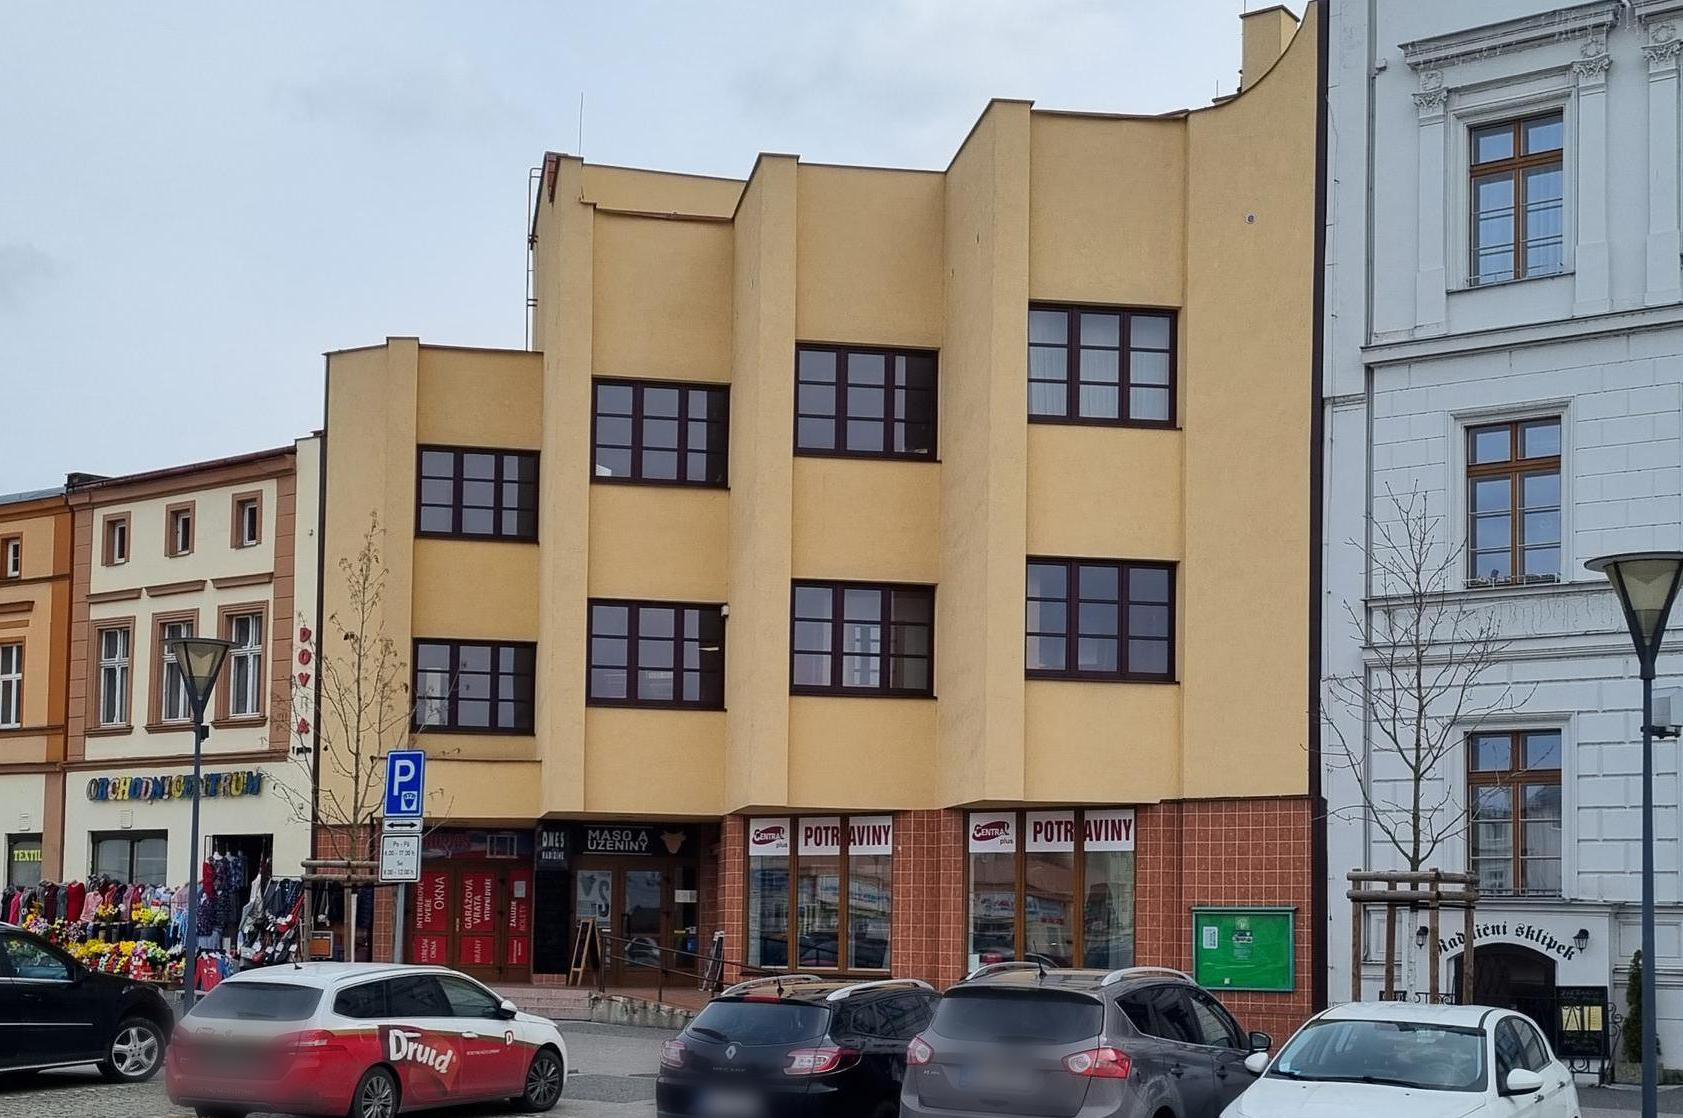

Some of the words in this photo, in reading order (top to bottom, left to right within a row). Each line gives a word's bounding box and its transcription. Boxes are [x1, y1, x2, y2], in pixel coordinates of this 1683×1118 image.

[393, 759, 416, 796] P
[588, 830, 632, 841] MASO
[638, 831, 648, 841] A
[587, 840, 649, 851] UZENINY
[14, 849, 42, 862] TEXTIL
[434, 876, 446, 910] OKNA
[506, 1032, 513, 1046] D
[389, 1029, 454, 1074] Druid
